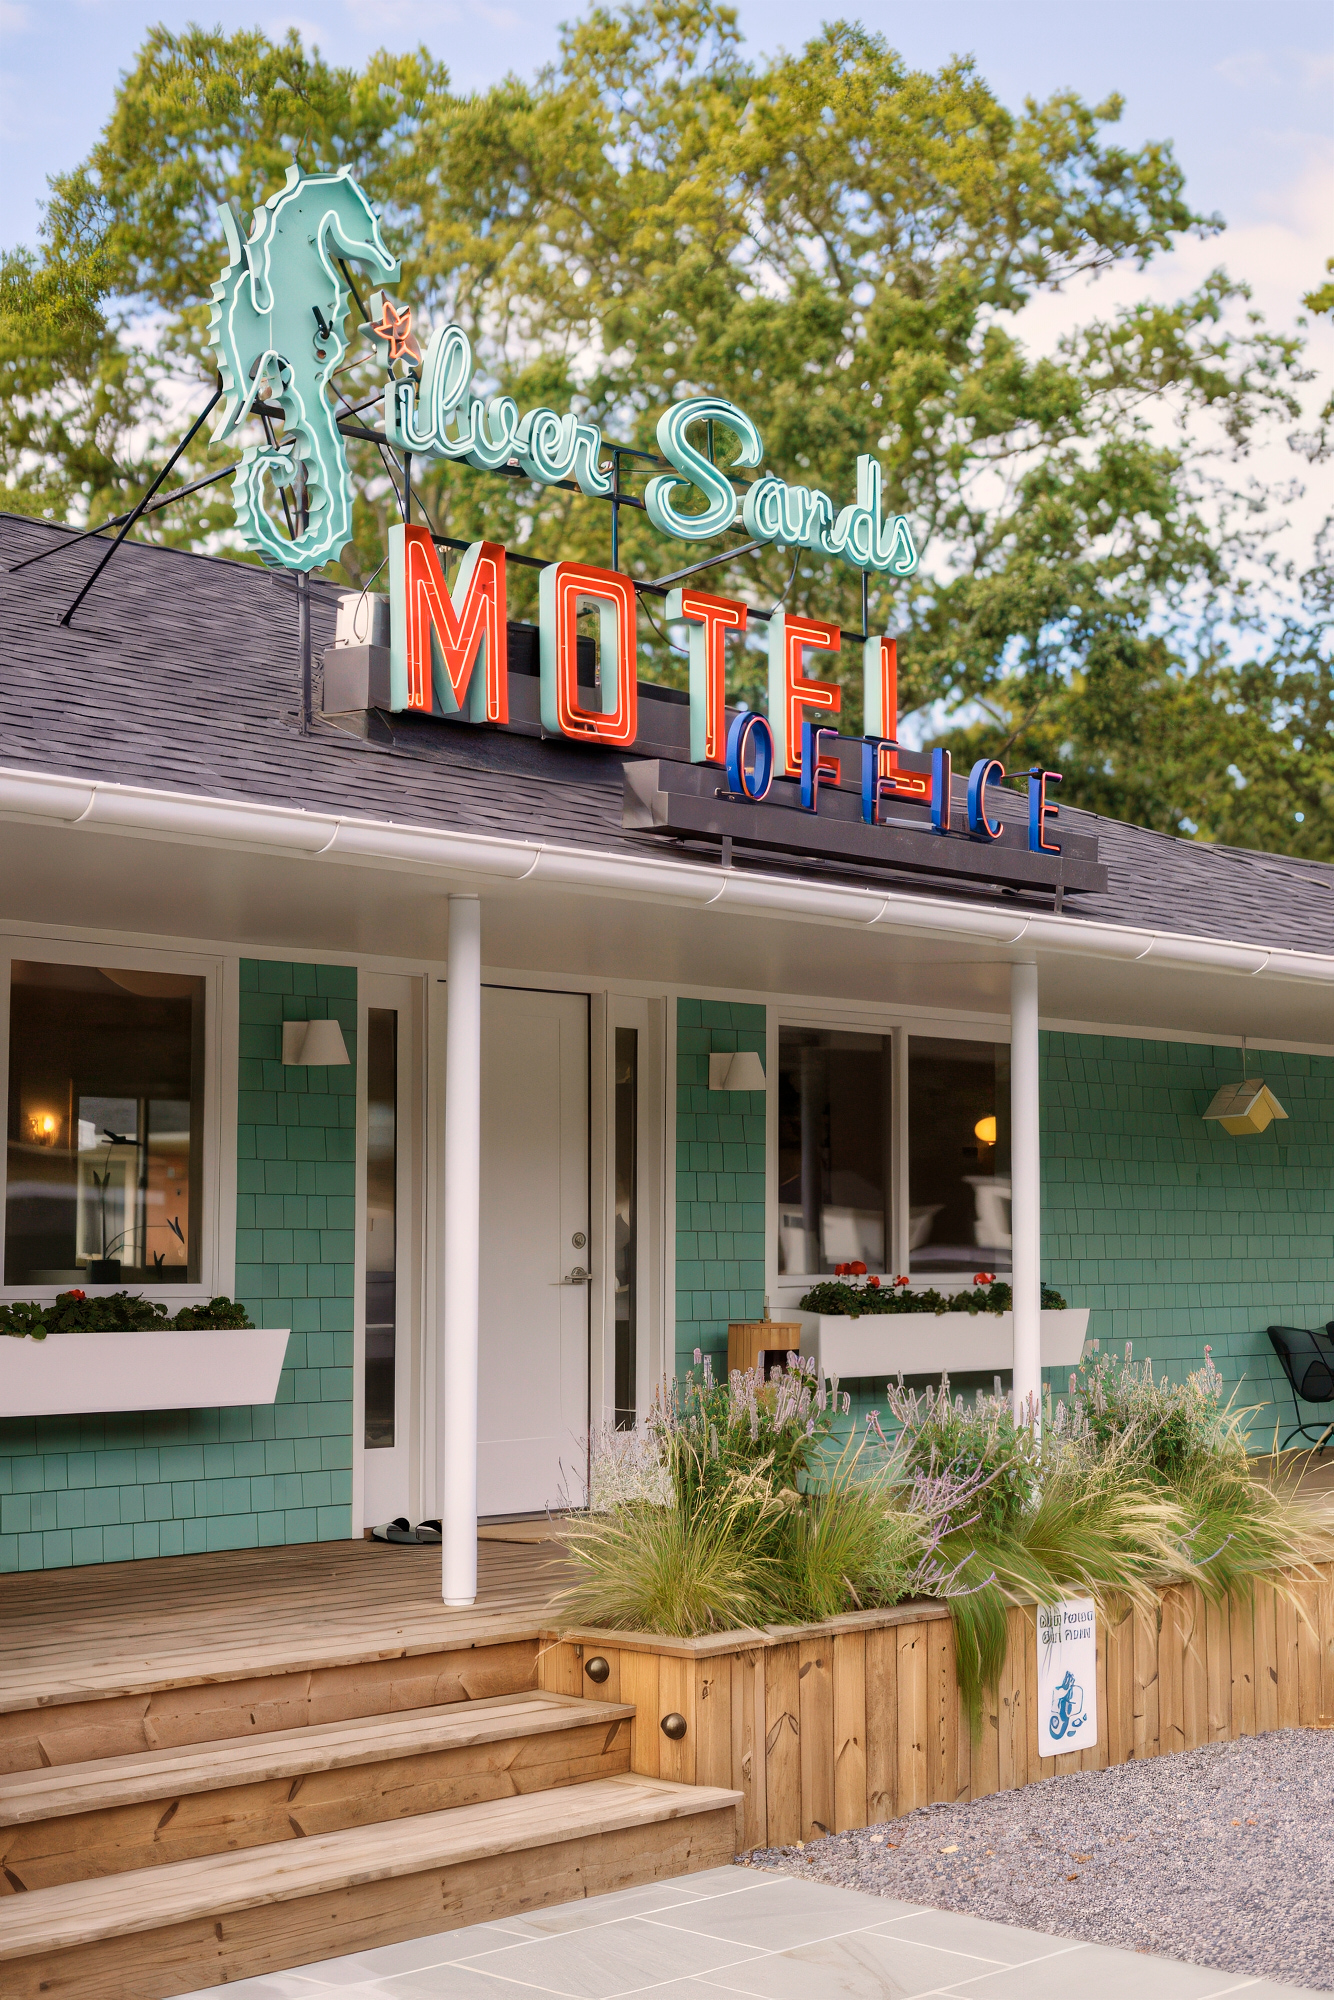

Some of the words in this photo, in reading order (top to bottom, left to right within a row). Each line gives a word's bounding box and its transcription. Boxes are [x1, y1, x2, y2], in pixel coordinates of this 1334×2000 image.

[643, 396, 920, 577] Sands
[388, 523, 932, 806] MOTEL
[725, 711, 1063, 855] OFFICE
